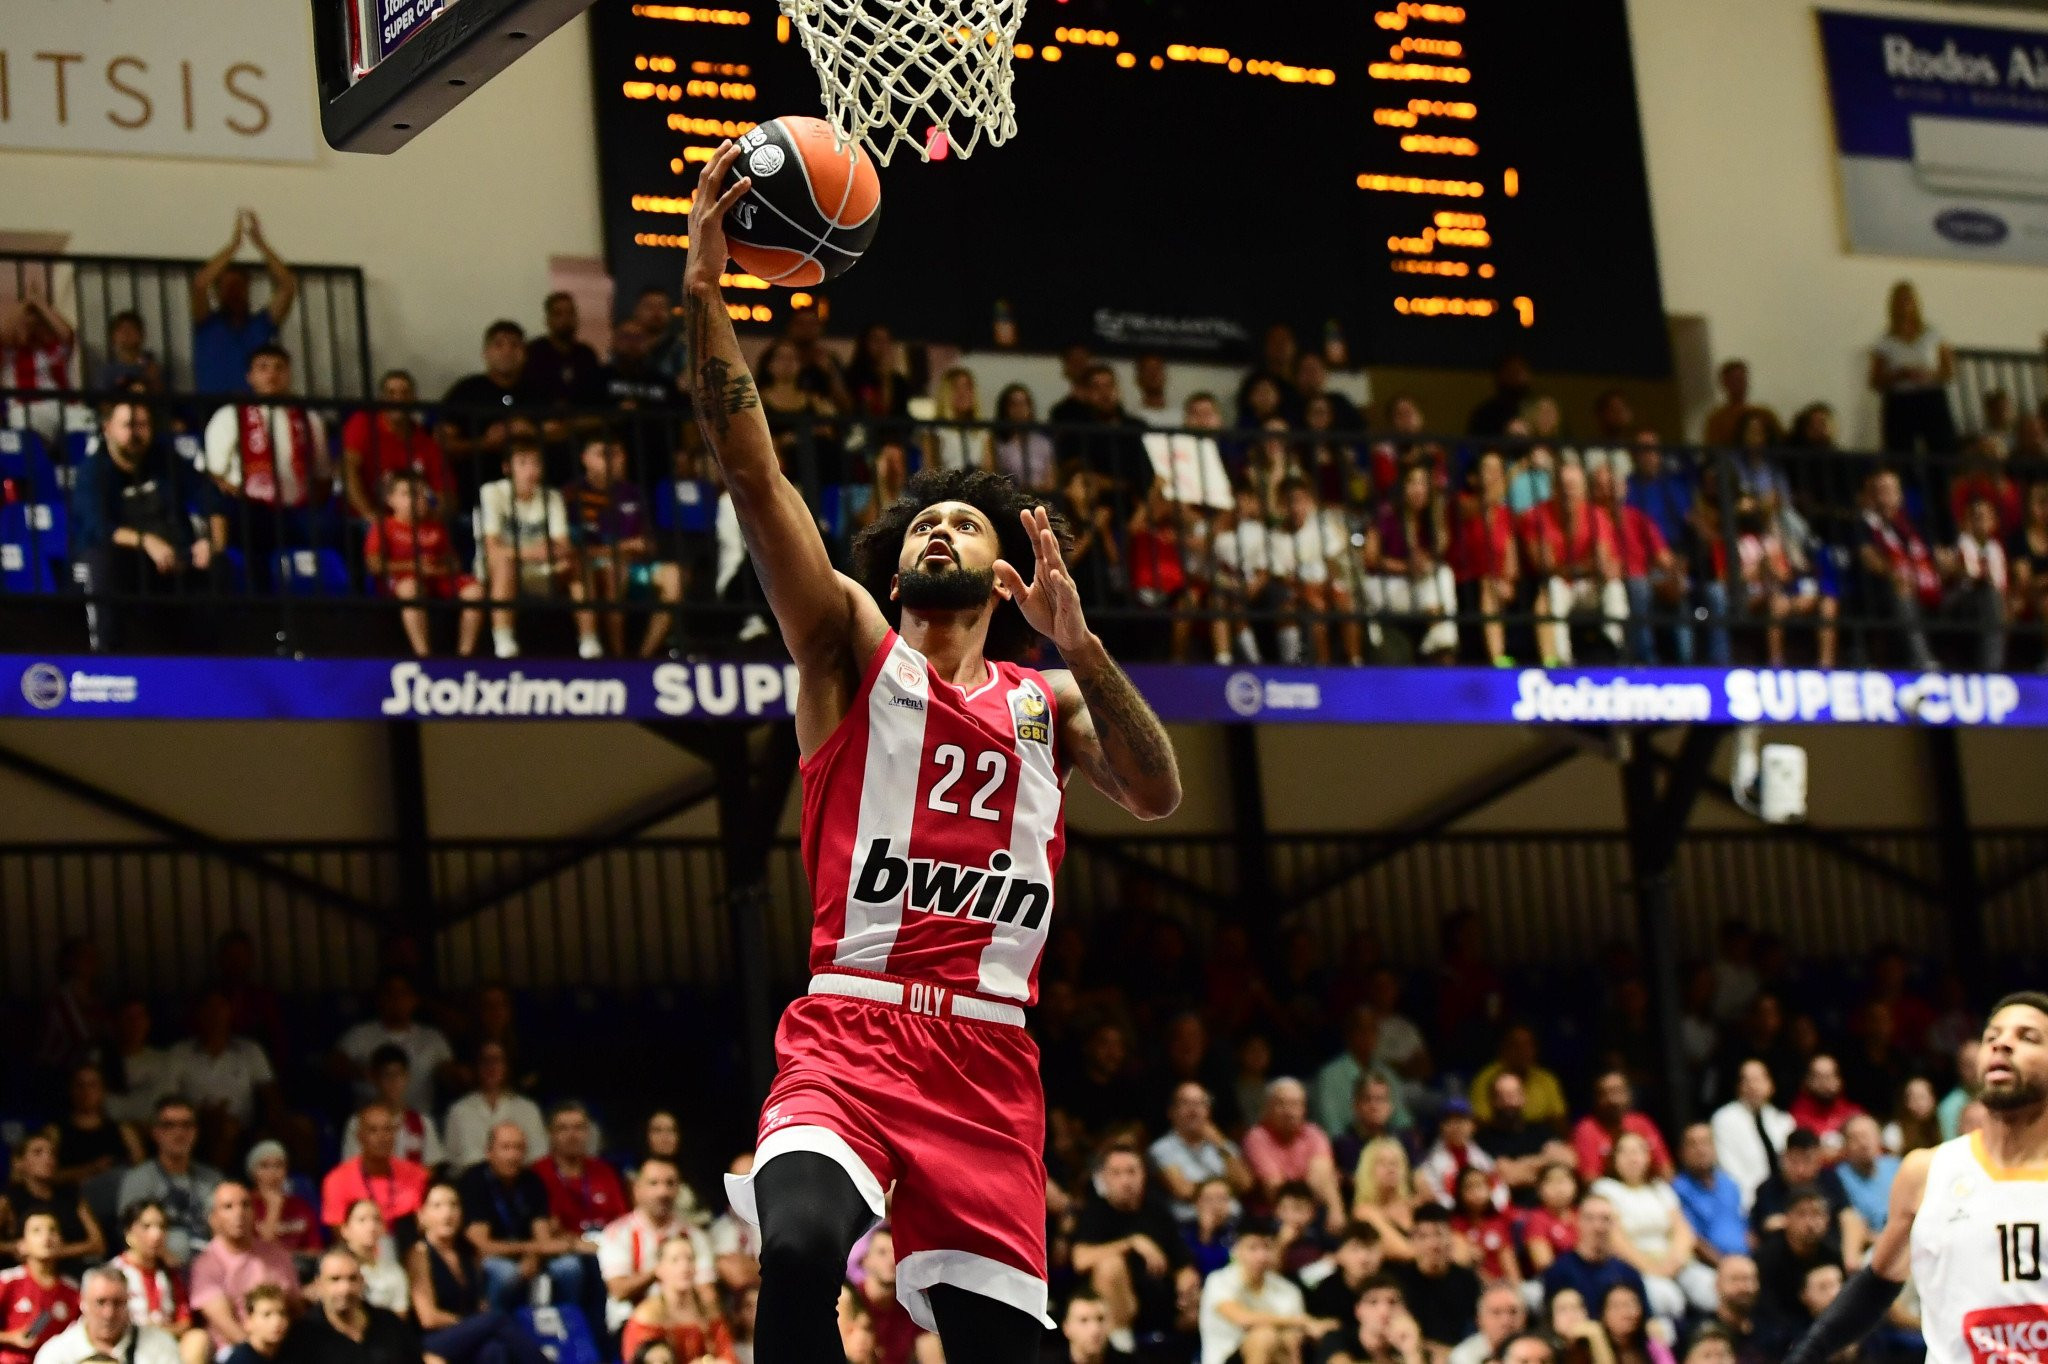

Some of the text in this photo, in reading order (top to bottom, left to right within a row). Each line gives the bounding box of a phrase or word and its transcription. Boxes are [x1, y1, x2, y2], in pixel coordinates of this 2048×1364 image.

[384, 7, 415, 43] SUPER
[382, 662, 627, 716] Stoiximan
[1512, 668, 2020, 724] Stoiximan SUPER CUP
[1019, 725, 1048, 742] GBL
[928, 743, 1008, 822] 22
[852, 838, 1050, 930] bwin
[909, 982, 946, 1017] OLY
[1996, 1223, 2041, 1282] 10
[1969, 1321, 2048, 1353] BIKO
